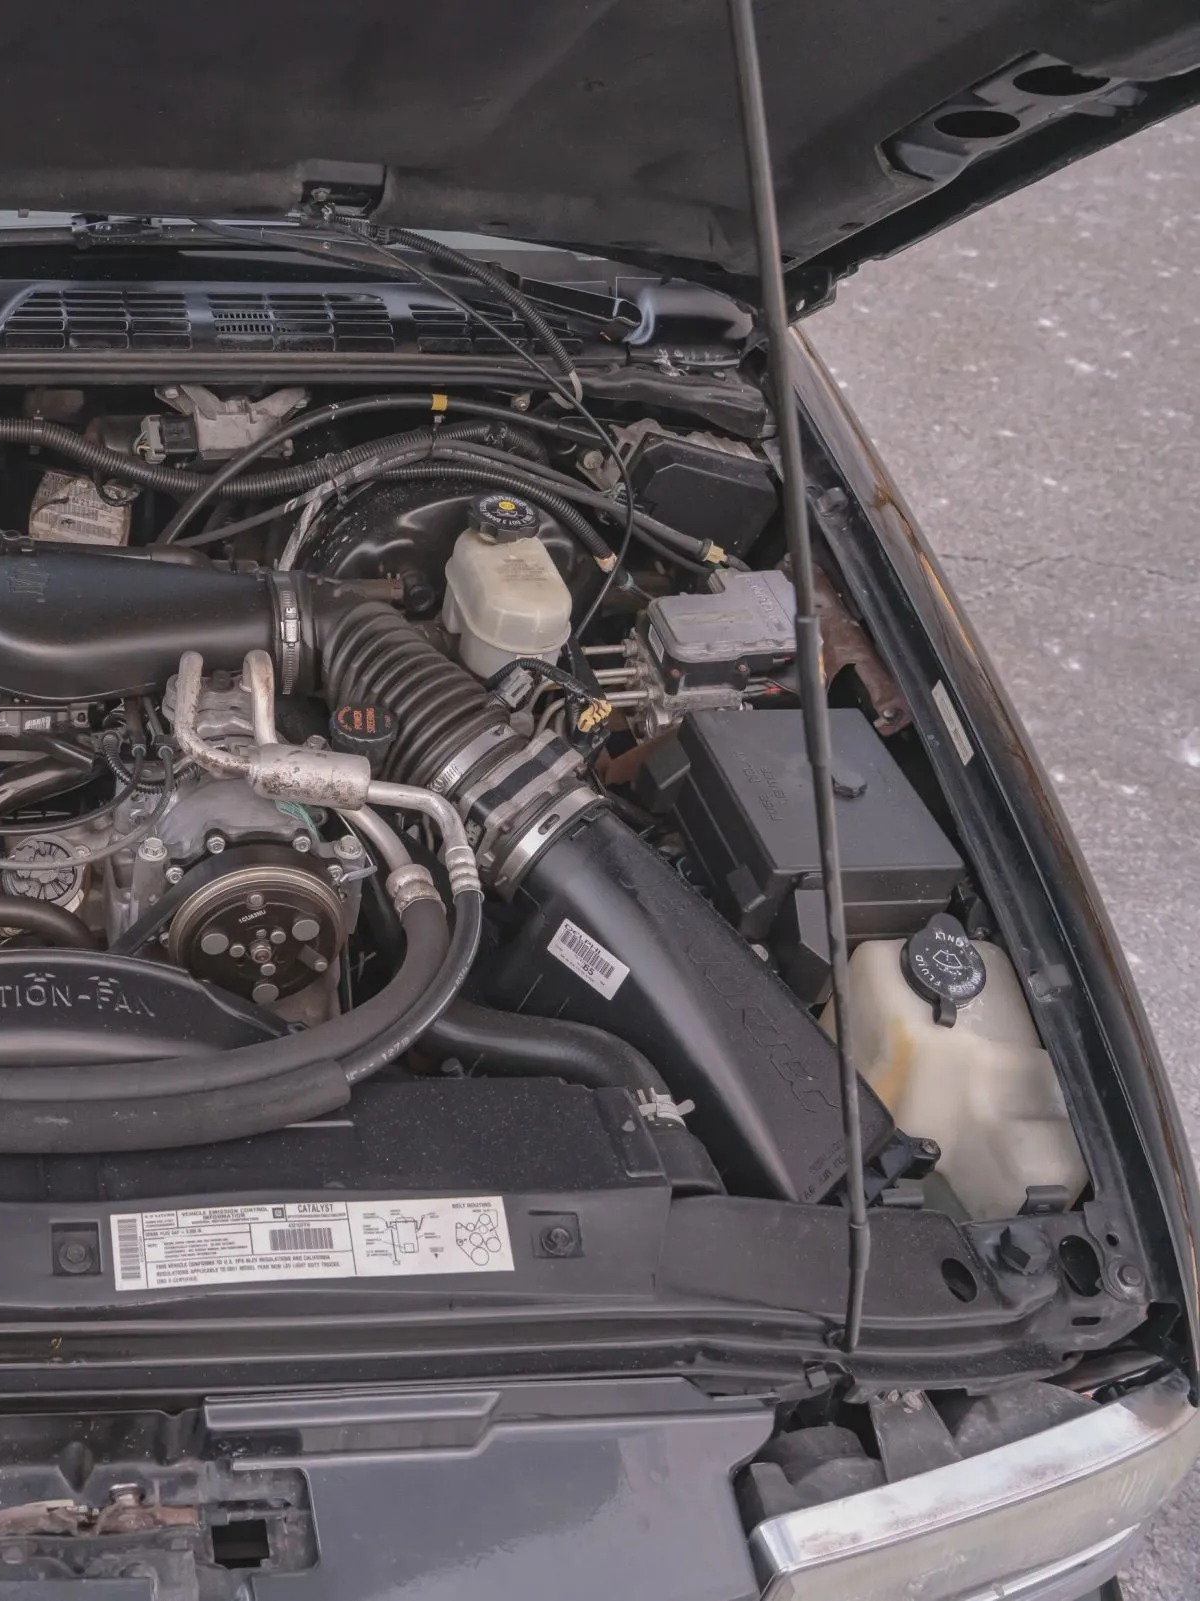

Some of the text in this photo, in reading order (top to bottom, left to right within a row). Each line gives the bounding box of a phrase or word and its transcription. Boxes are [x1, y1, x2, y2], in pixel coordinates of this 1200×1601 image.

[935, 932, 965, 947] ONLY
[916, 954, 941, 986] FLUID
[297, 1203, 333, 1214] CATALYST
